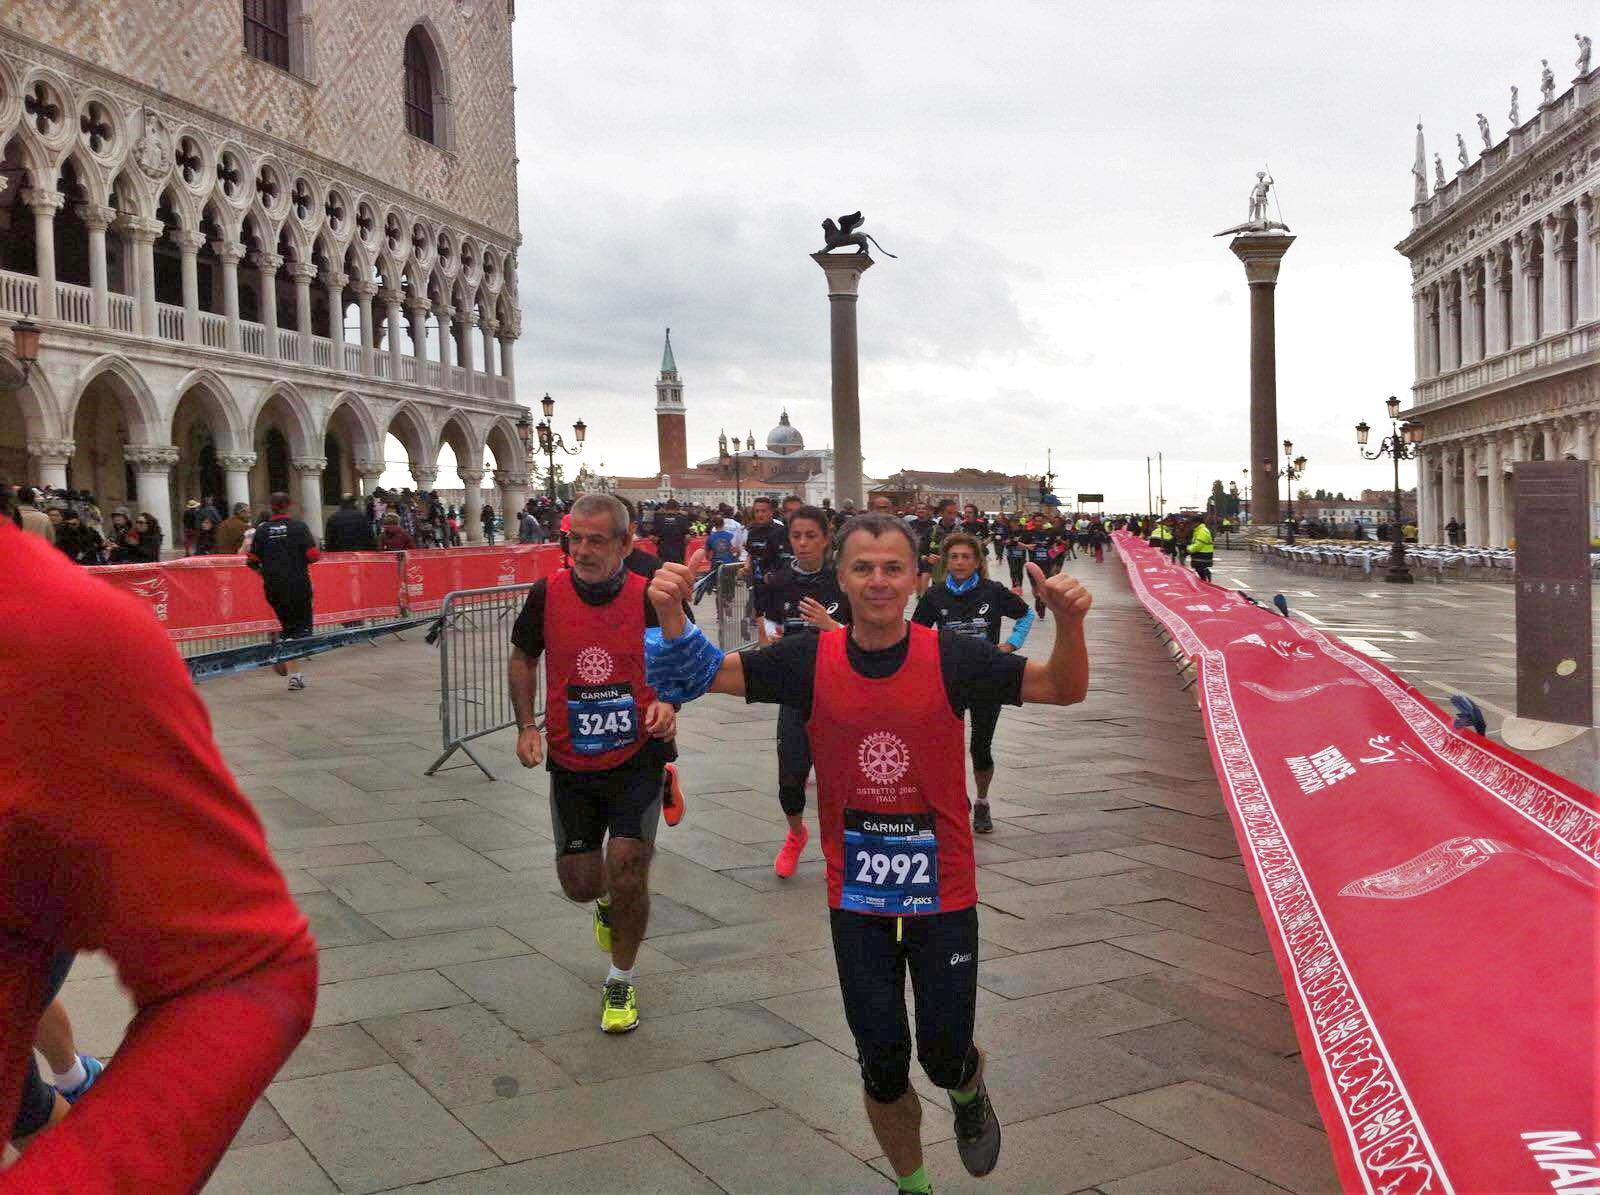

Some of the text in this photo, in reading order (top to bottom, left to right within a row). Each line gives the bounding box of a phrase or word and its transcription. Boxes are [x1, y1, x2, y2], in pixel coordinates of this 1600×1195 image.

[581, 690, 619, 700] GARMIN
[578, 710, 632, 736] 3243
[1309, 745, 1357, 786] VENICE
[875, 795, 897, 803] ITALY
[863, 821, 914, 833] GARMIN
[856, 850, 930, 885] 2992
[1520, 1131, 1600, 1195] MA
